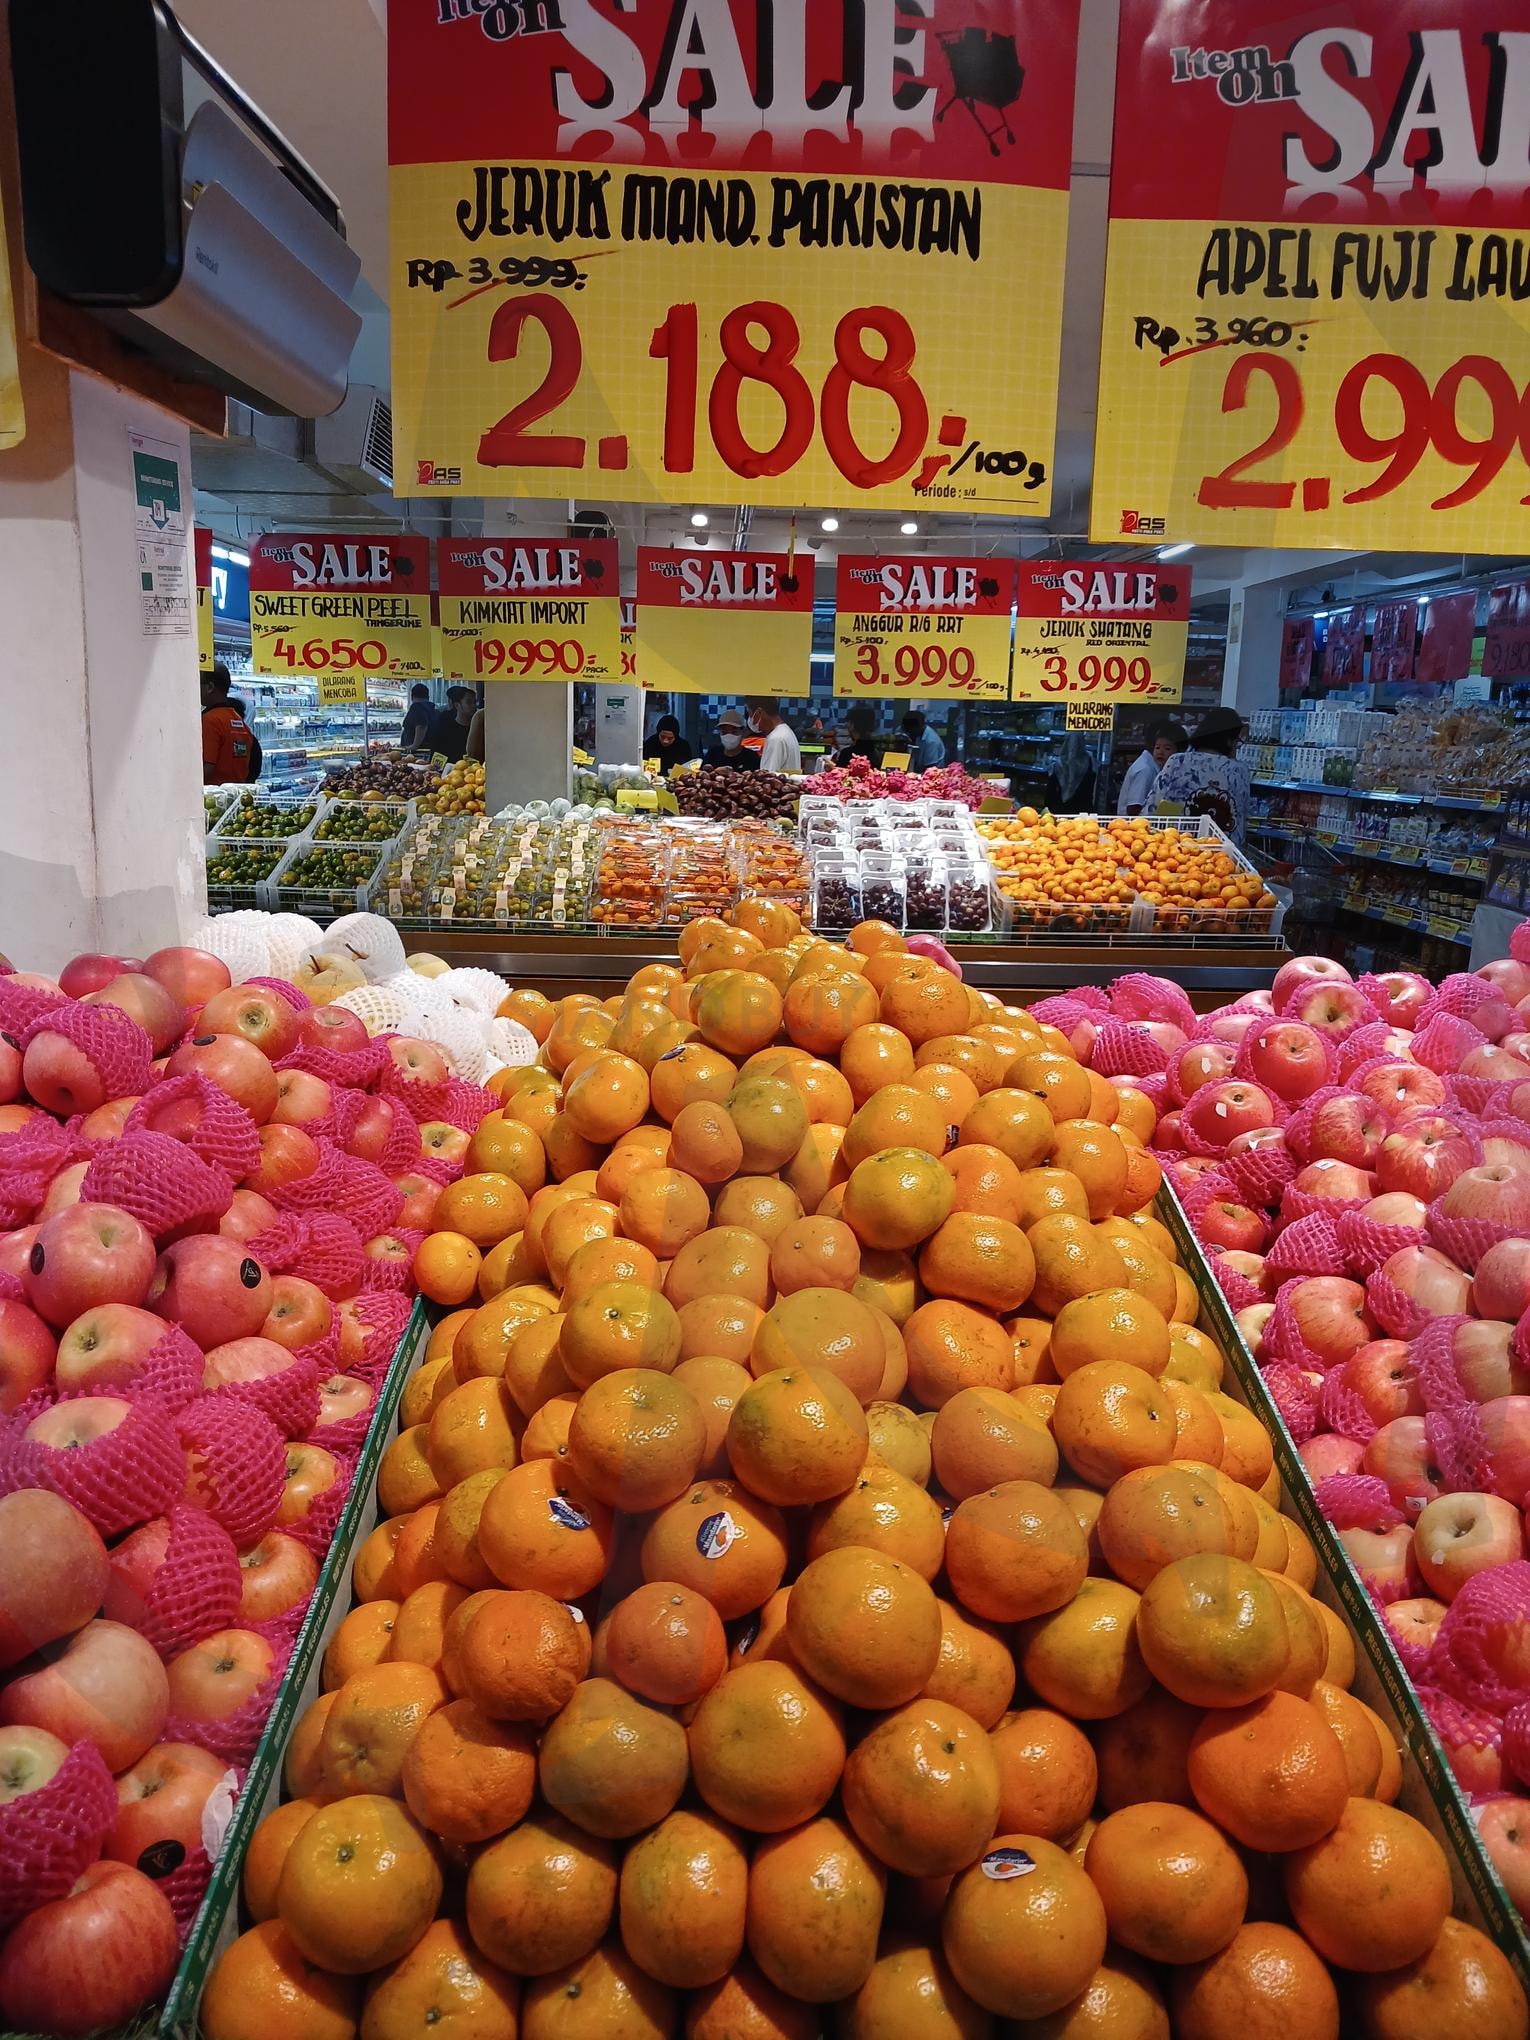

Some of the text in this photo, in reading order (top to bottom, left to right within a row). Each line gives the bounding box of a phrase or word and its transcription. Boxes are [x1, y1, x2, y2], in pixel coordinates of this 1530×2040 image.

[551, 0, 938, 124] SALE
[1170, 45, 1269, 83] Item
[1217, 59, 1300, 106] on
[456, 167, 612, 243] JERUK
[770, 177, 983, 262] PAKISTAN
[1197, 227, 1319, 300] APEL
[1331, 230, 1437, 301] FUJI
[292, 542, 392, 584] SALE
[482, 547, 582, 588] SALE
[680, 558, 777, 600] SALE
[879, 564, 977, 604] SALE
[1061, 569, 1157, 610] SALE
[254, 594, 419, 618] SWEET GREEN PEEL
[364, 618, 423, 629] TANGERINE
[530, 601, 589, 625] IMPORT
[853, 614, 904, 633] ANGGUR
[1040, 620, 1153, 639] JERUK SHATANG
[323, 688, 357, 699] MENCOBA
[1069, 702, 1113, 715] DILARANG
[1068, 716, 1112, 729] MENCOBA
[1307, 1517, 1340, 1572] VEGETABLES
[1379, 1660, 1415, 1731] VEGETABLES
